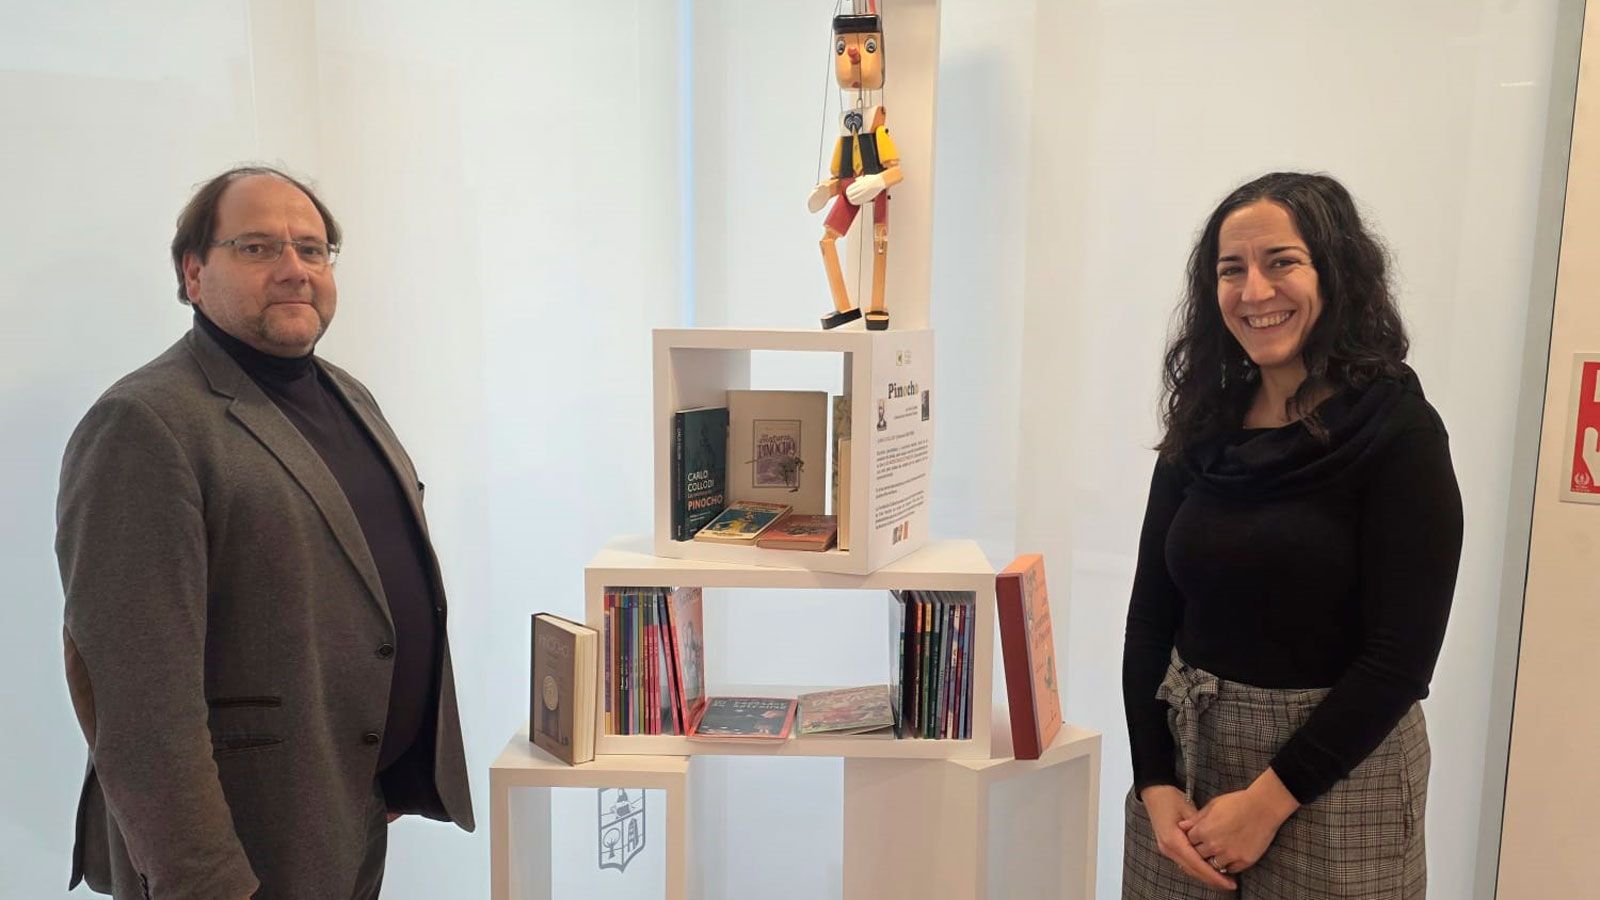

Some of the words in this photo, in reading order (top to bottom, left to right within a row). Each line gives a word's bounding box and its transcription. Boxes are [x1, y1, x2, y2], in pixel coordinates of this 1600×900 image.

[888, 380, 919, 399] Pinocho
[687, 470, 708, 481] CARLO
[687, 480, 714, 492] COLLODI
[688, 494, 723, 511] PINOCHO
